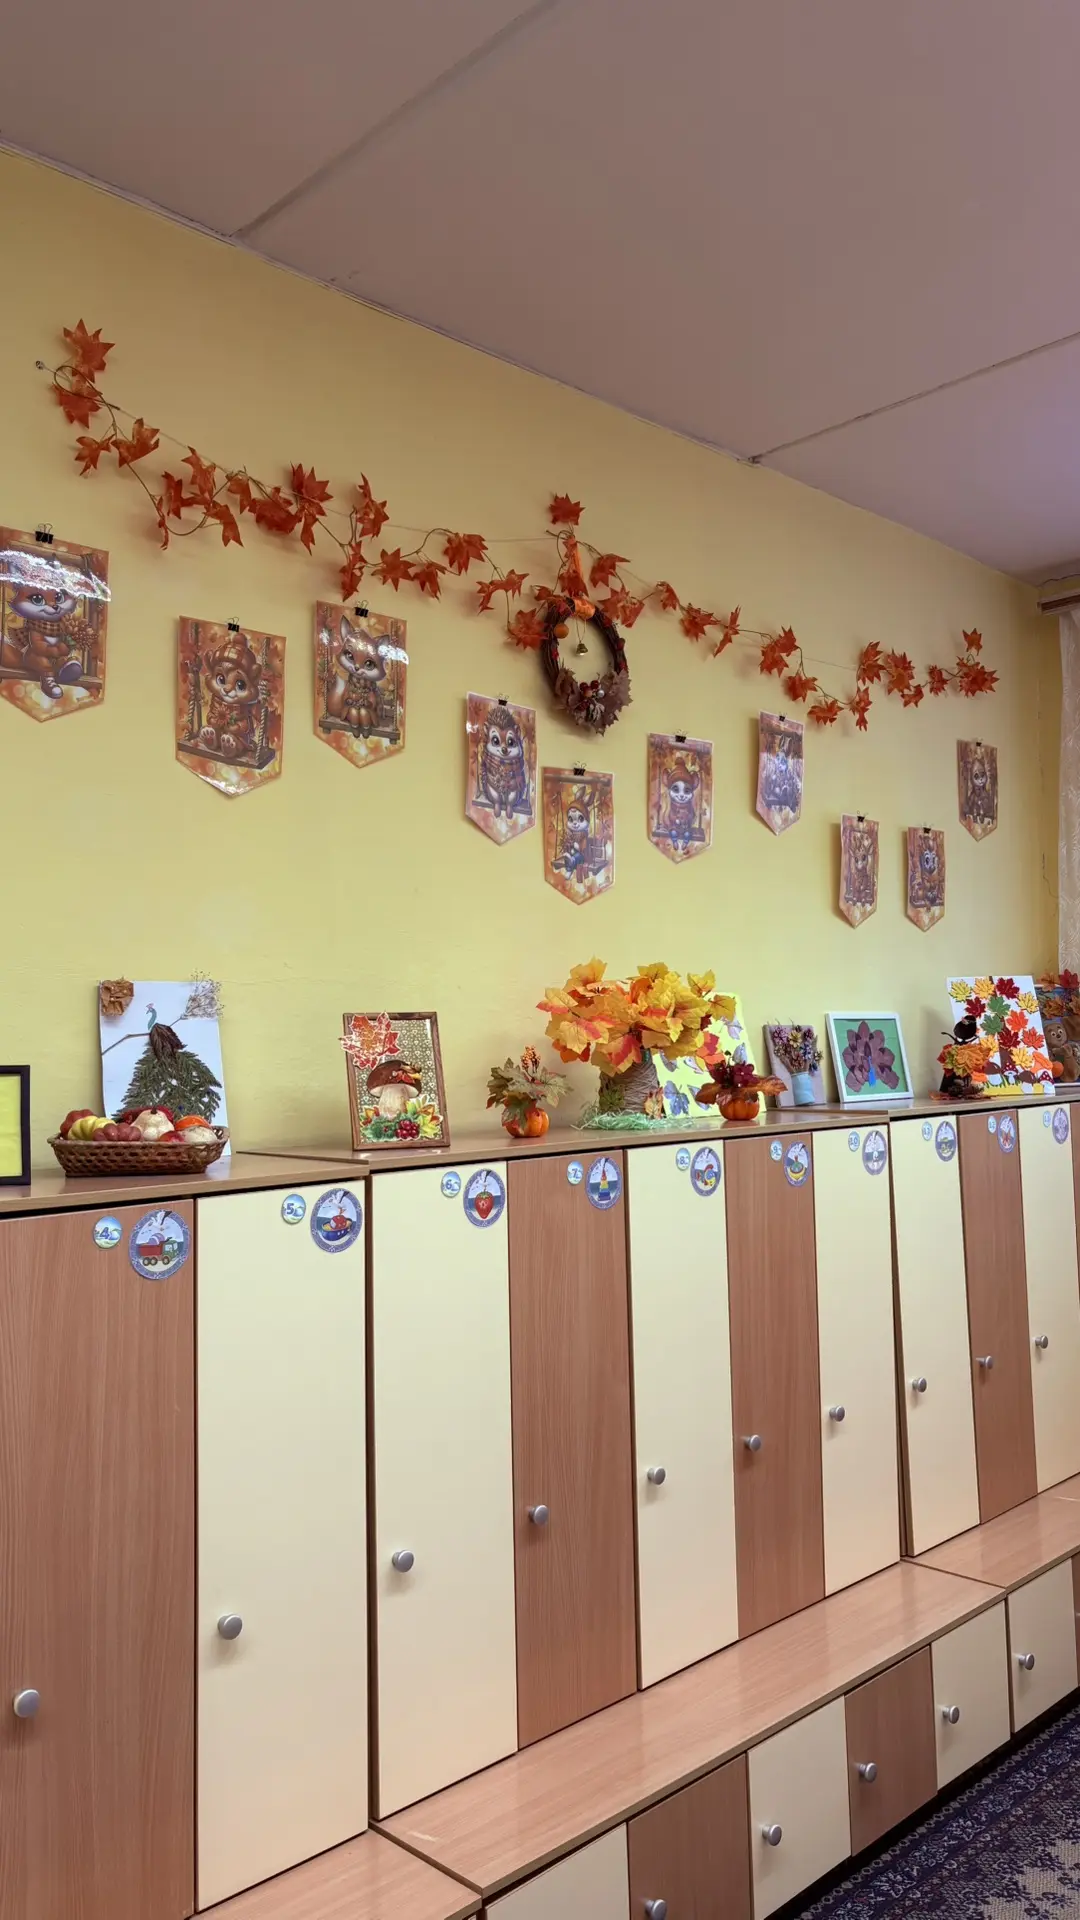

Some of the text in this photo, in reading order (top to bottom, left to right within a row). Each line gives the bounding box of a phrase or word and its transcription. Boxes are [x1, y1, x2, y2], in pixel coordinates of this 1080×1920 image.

[679, 1155, 685, 1165] 8
[572, 1168, 578, 1178] 7
[445, 1179, 452, 1190] 6
[286, 1203, 295, 1215] 5
[99, 1226, 110, 1239] 4
